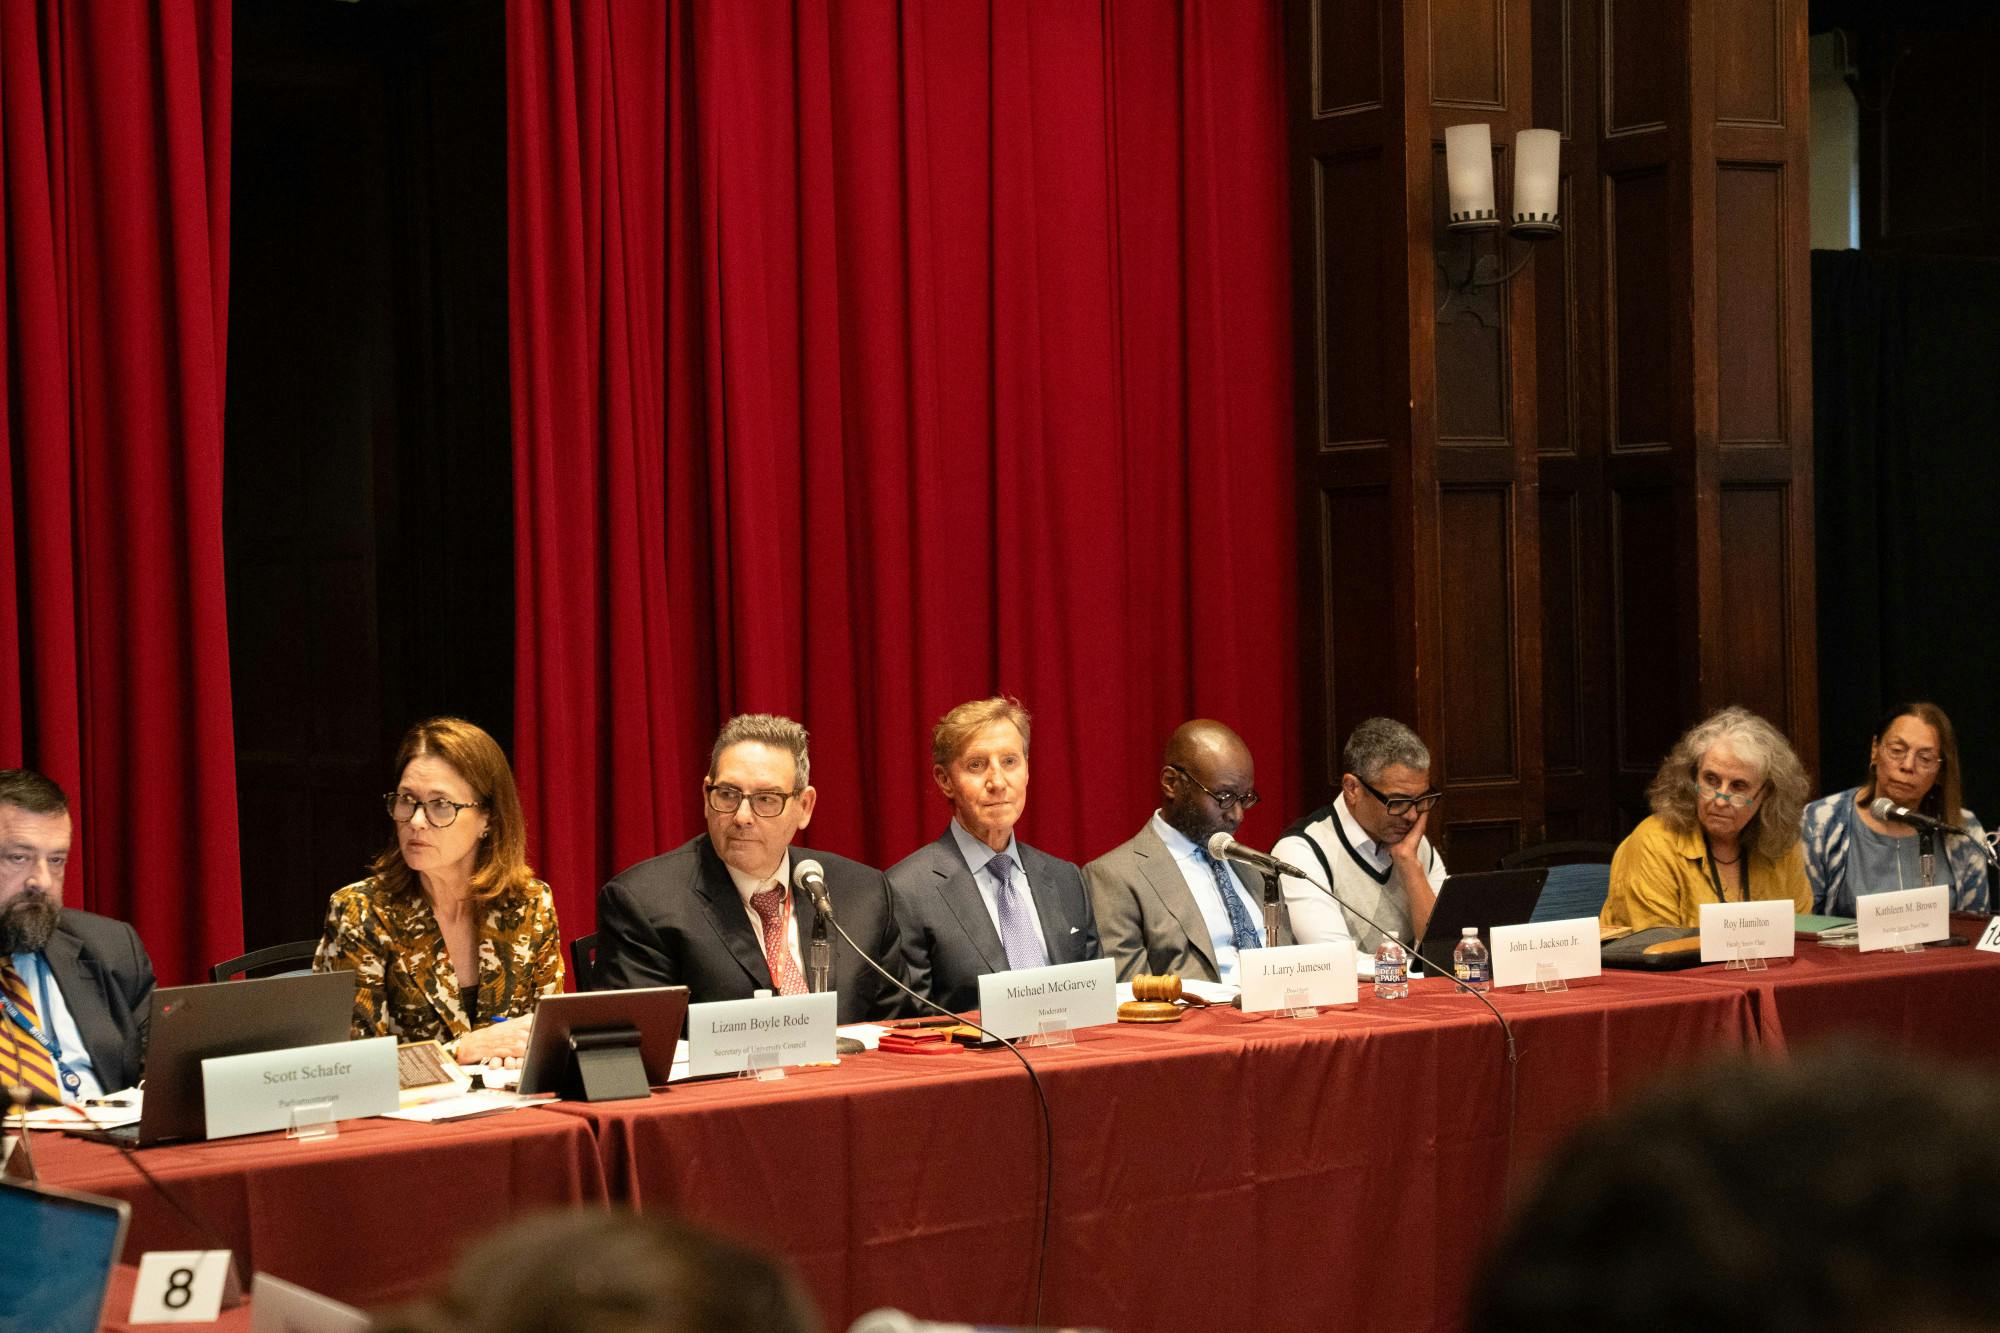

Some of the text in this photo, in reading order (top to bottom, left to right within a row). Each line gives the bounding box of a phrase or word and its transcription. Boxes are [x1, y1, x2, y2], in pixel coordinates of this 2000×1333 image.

[1875, 901, 1938, 917] Kathleen M. Brown
[1723, 917, 1770, 931] Roy Hamilton
[1509, 936, 1580, 953] John L. Jackson Jr.
[1263, 962, 1331, 977] J. Larry Jameson
[1380, 974, 1400, 982] PARK
[1007, 979, 1097, 1000] Michael McGarvey
[1038, 1006, 1067, 1017] Moderator
[711, 1013, 810, 1034] Lizann Boyle Rode
[714, 1047, 741, 1057] Secretary
[783, 1040, 807, 1049] Council
[263, 1062, 352, 1085] Scott Schafer
[165, 1268, 193, 1309] 8
